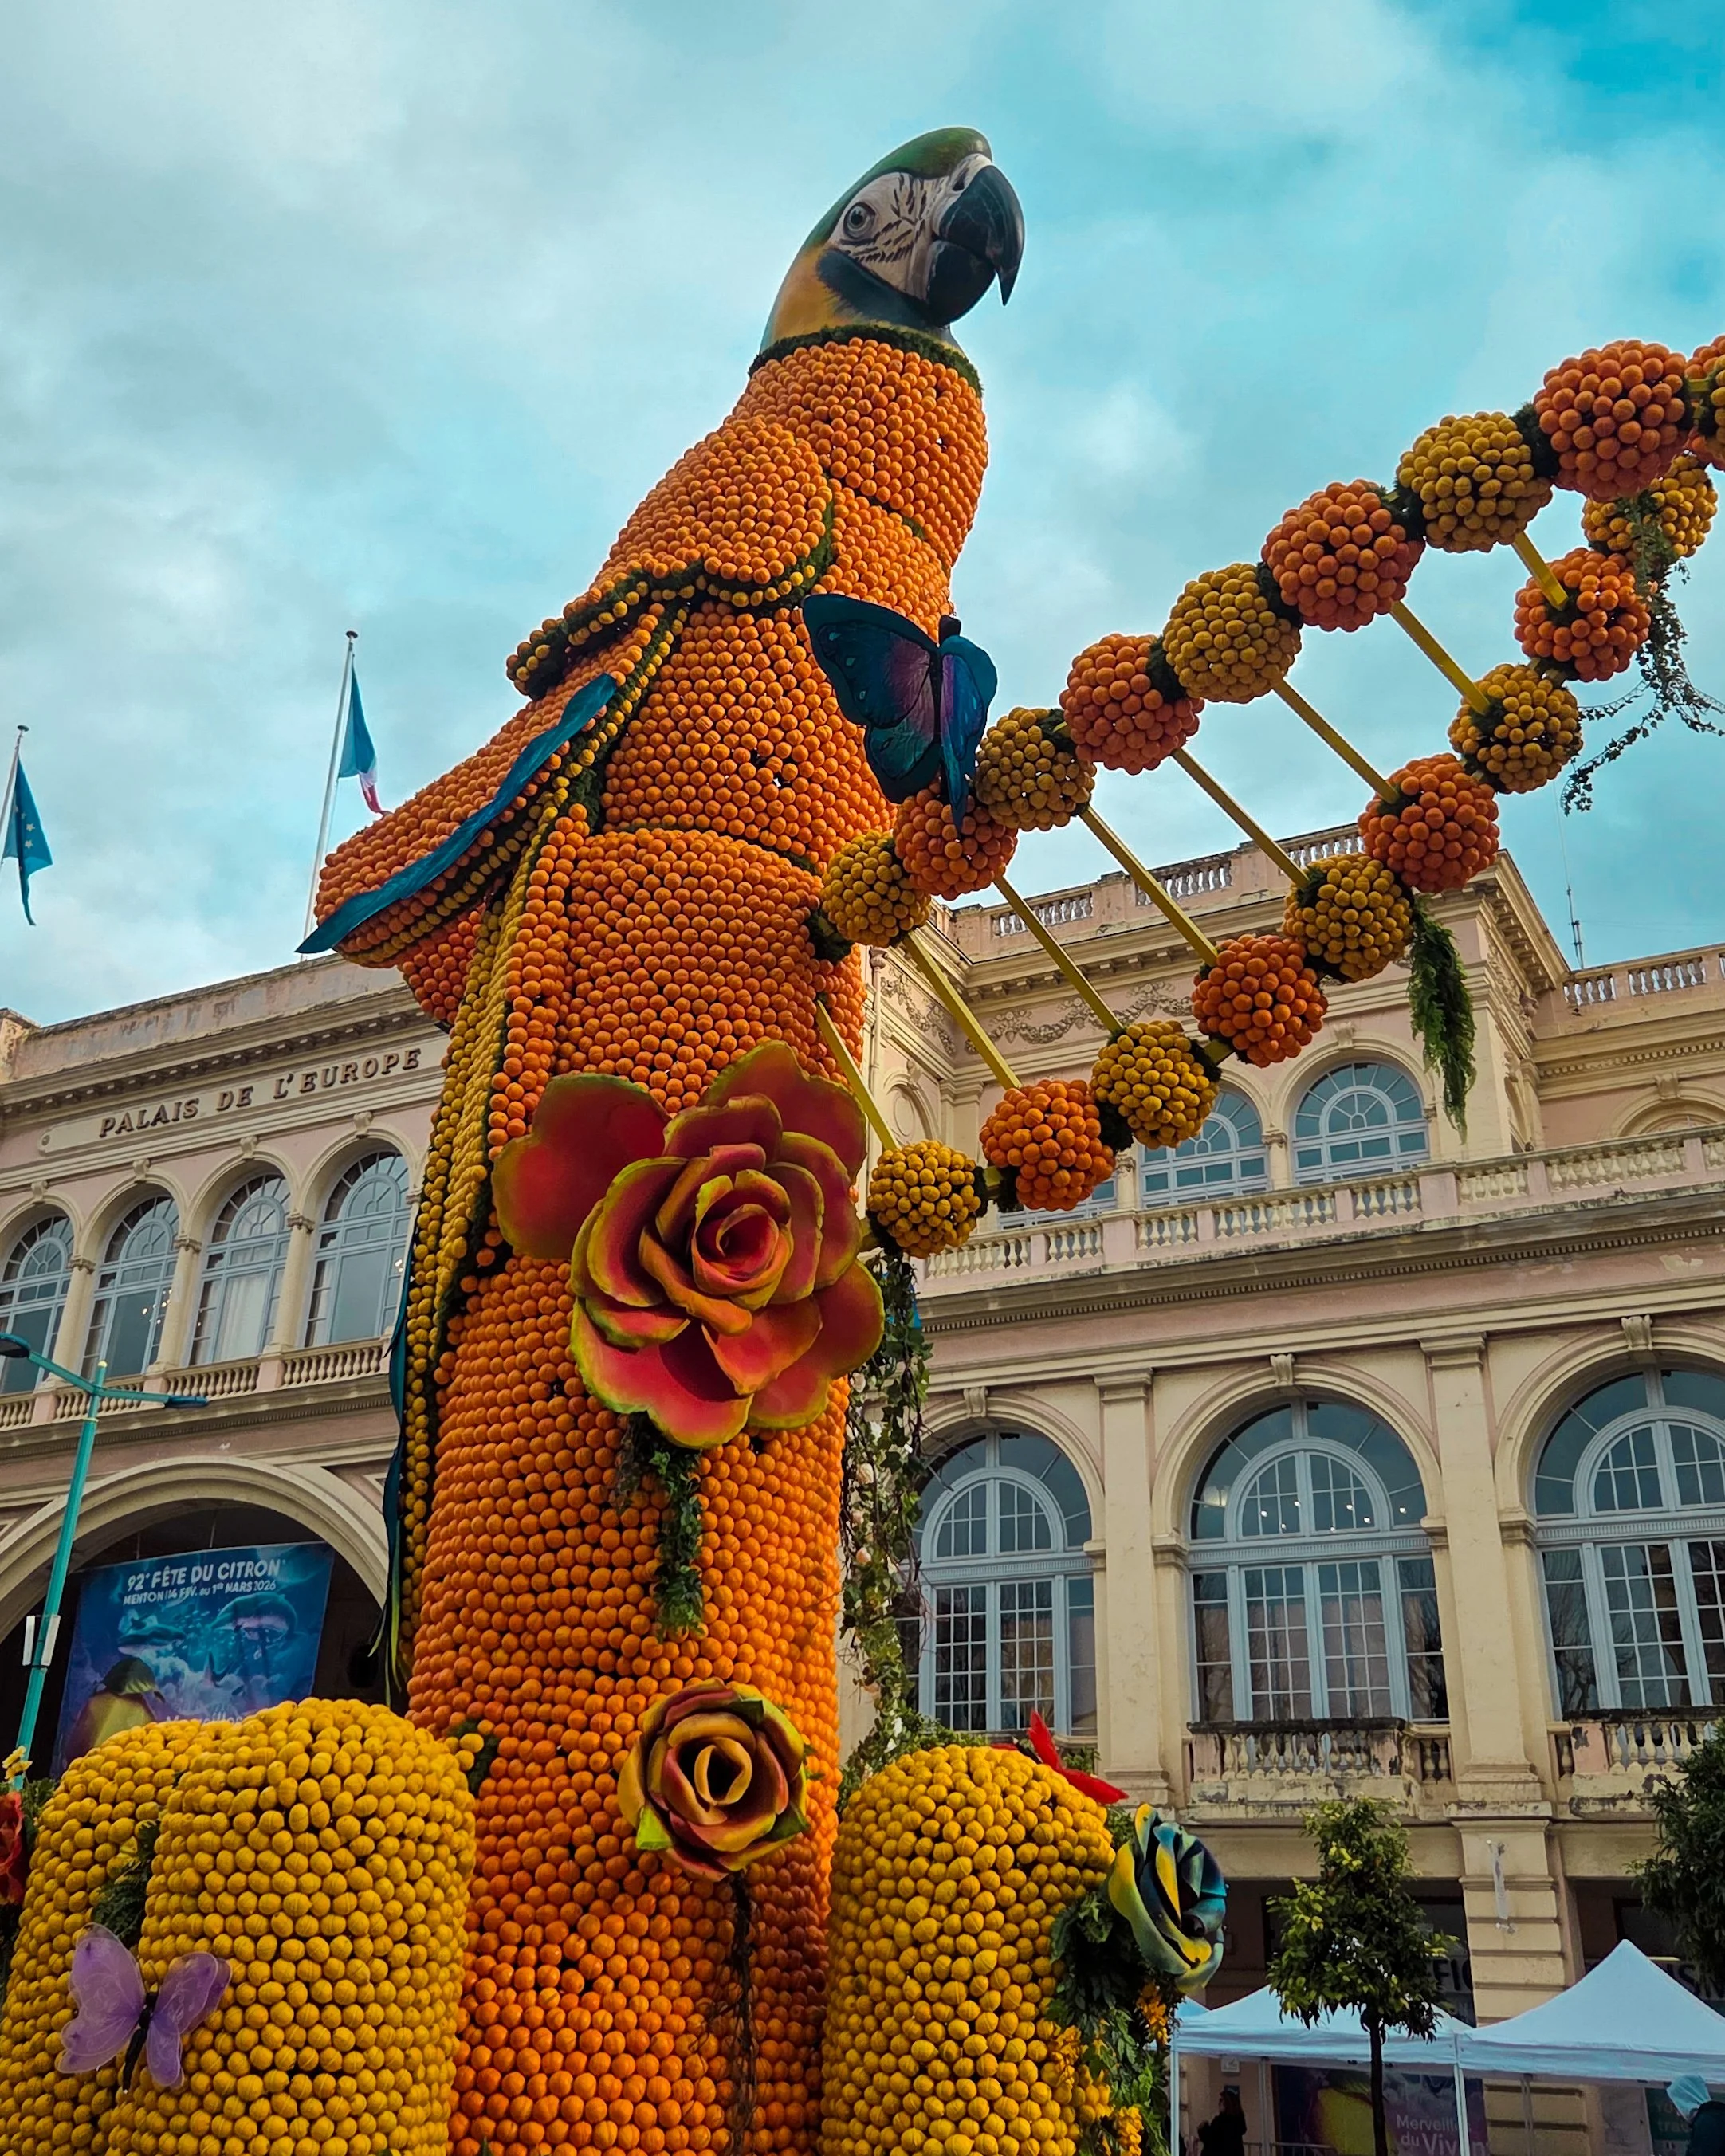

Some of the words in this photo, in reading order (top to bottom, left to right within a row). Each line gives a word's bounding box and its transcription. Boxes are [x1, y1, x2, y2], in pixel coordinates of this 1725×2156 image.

[99, 1098, 199, 1137] PALAIS
[215, 1086, 253, 1112] DE
[273, 1048, 422, 1101] L'EUROPE
[151, 1565, 188, 1589] FÊTE
[191, 1564, 214, 1584] DU
[123, 1591, 164, 1606] MENTON
[224, 1581, 253, 1595] MARS
[253, 1579, 277, 1592] 2026
[1401, 2131, 1420, 2147] du
